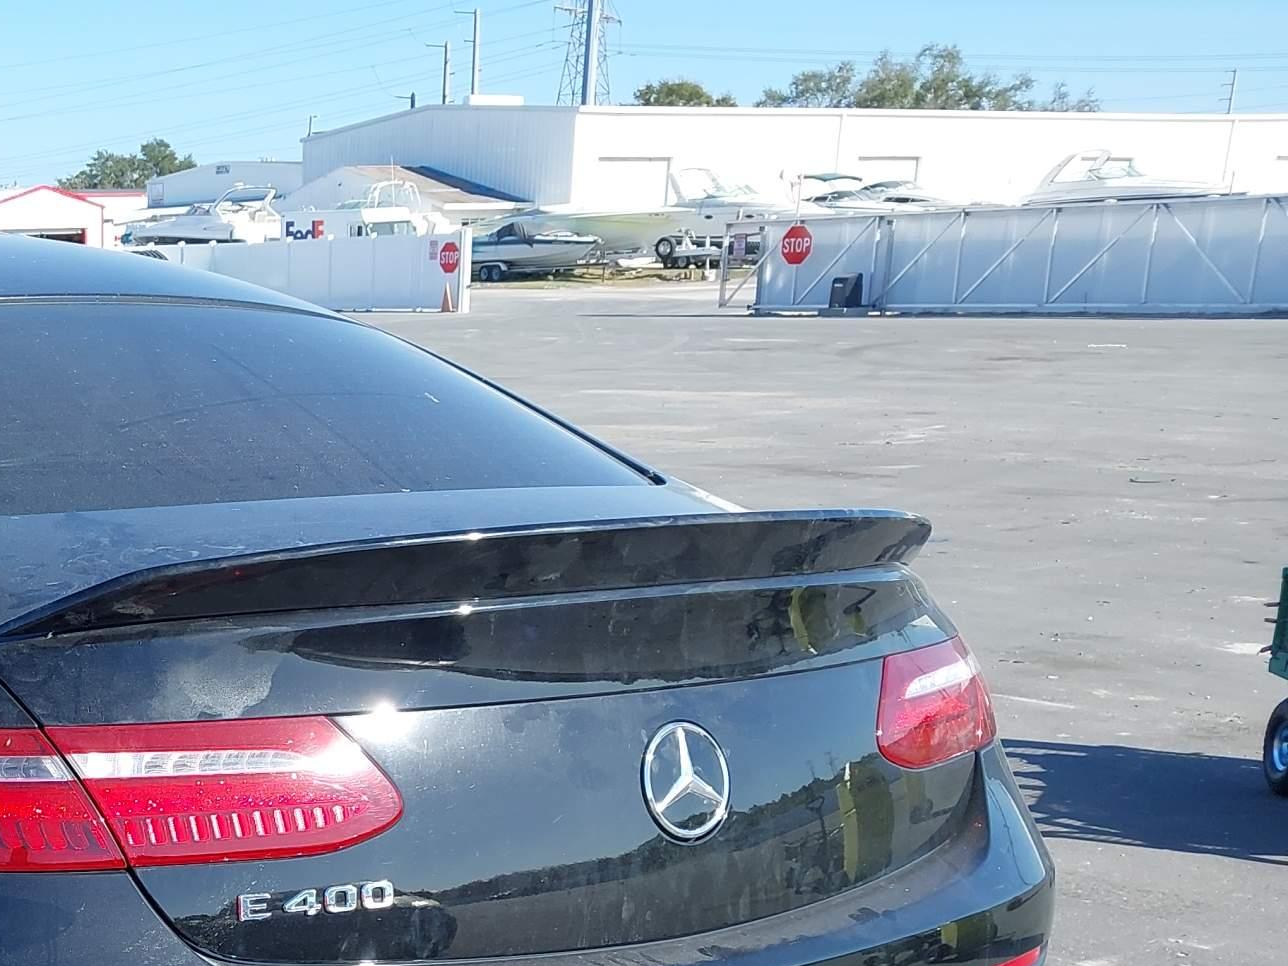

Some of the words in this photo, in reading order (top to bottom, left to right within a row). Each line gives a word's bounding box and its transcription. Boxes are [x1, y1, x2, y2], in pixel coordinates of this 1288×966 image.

[783, 238, 810, 253] STOP
[441, 251, 459, 264] STOP
[236, 893, 272, 922] E
[283, 880, 395, 916] 400
